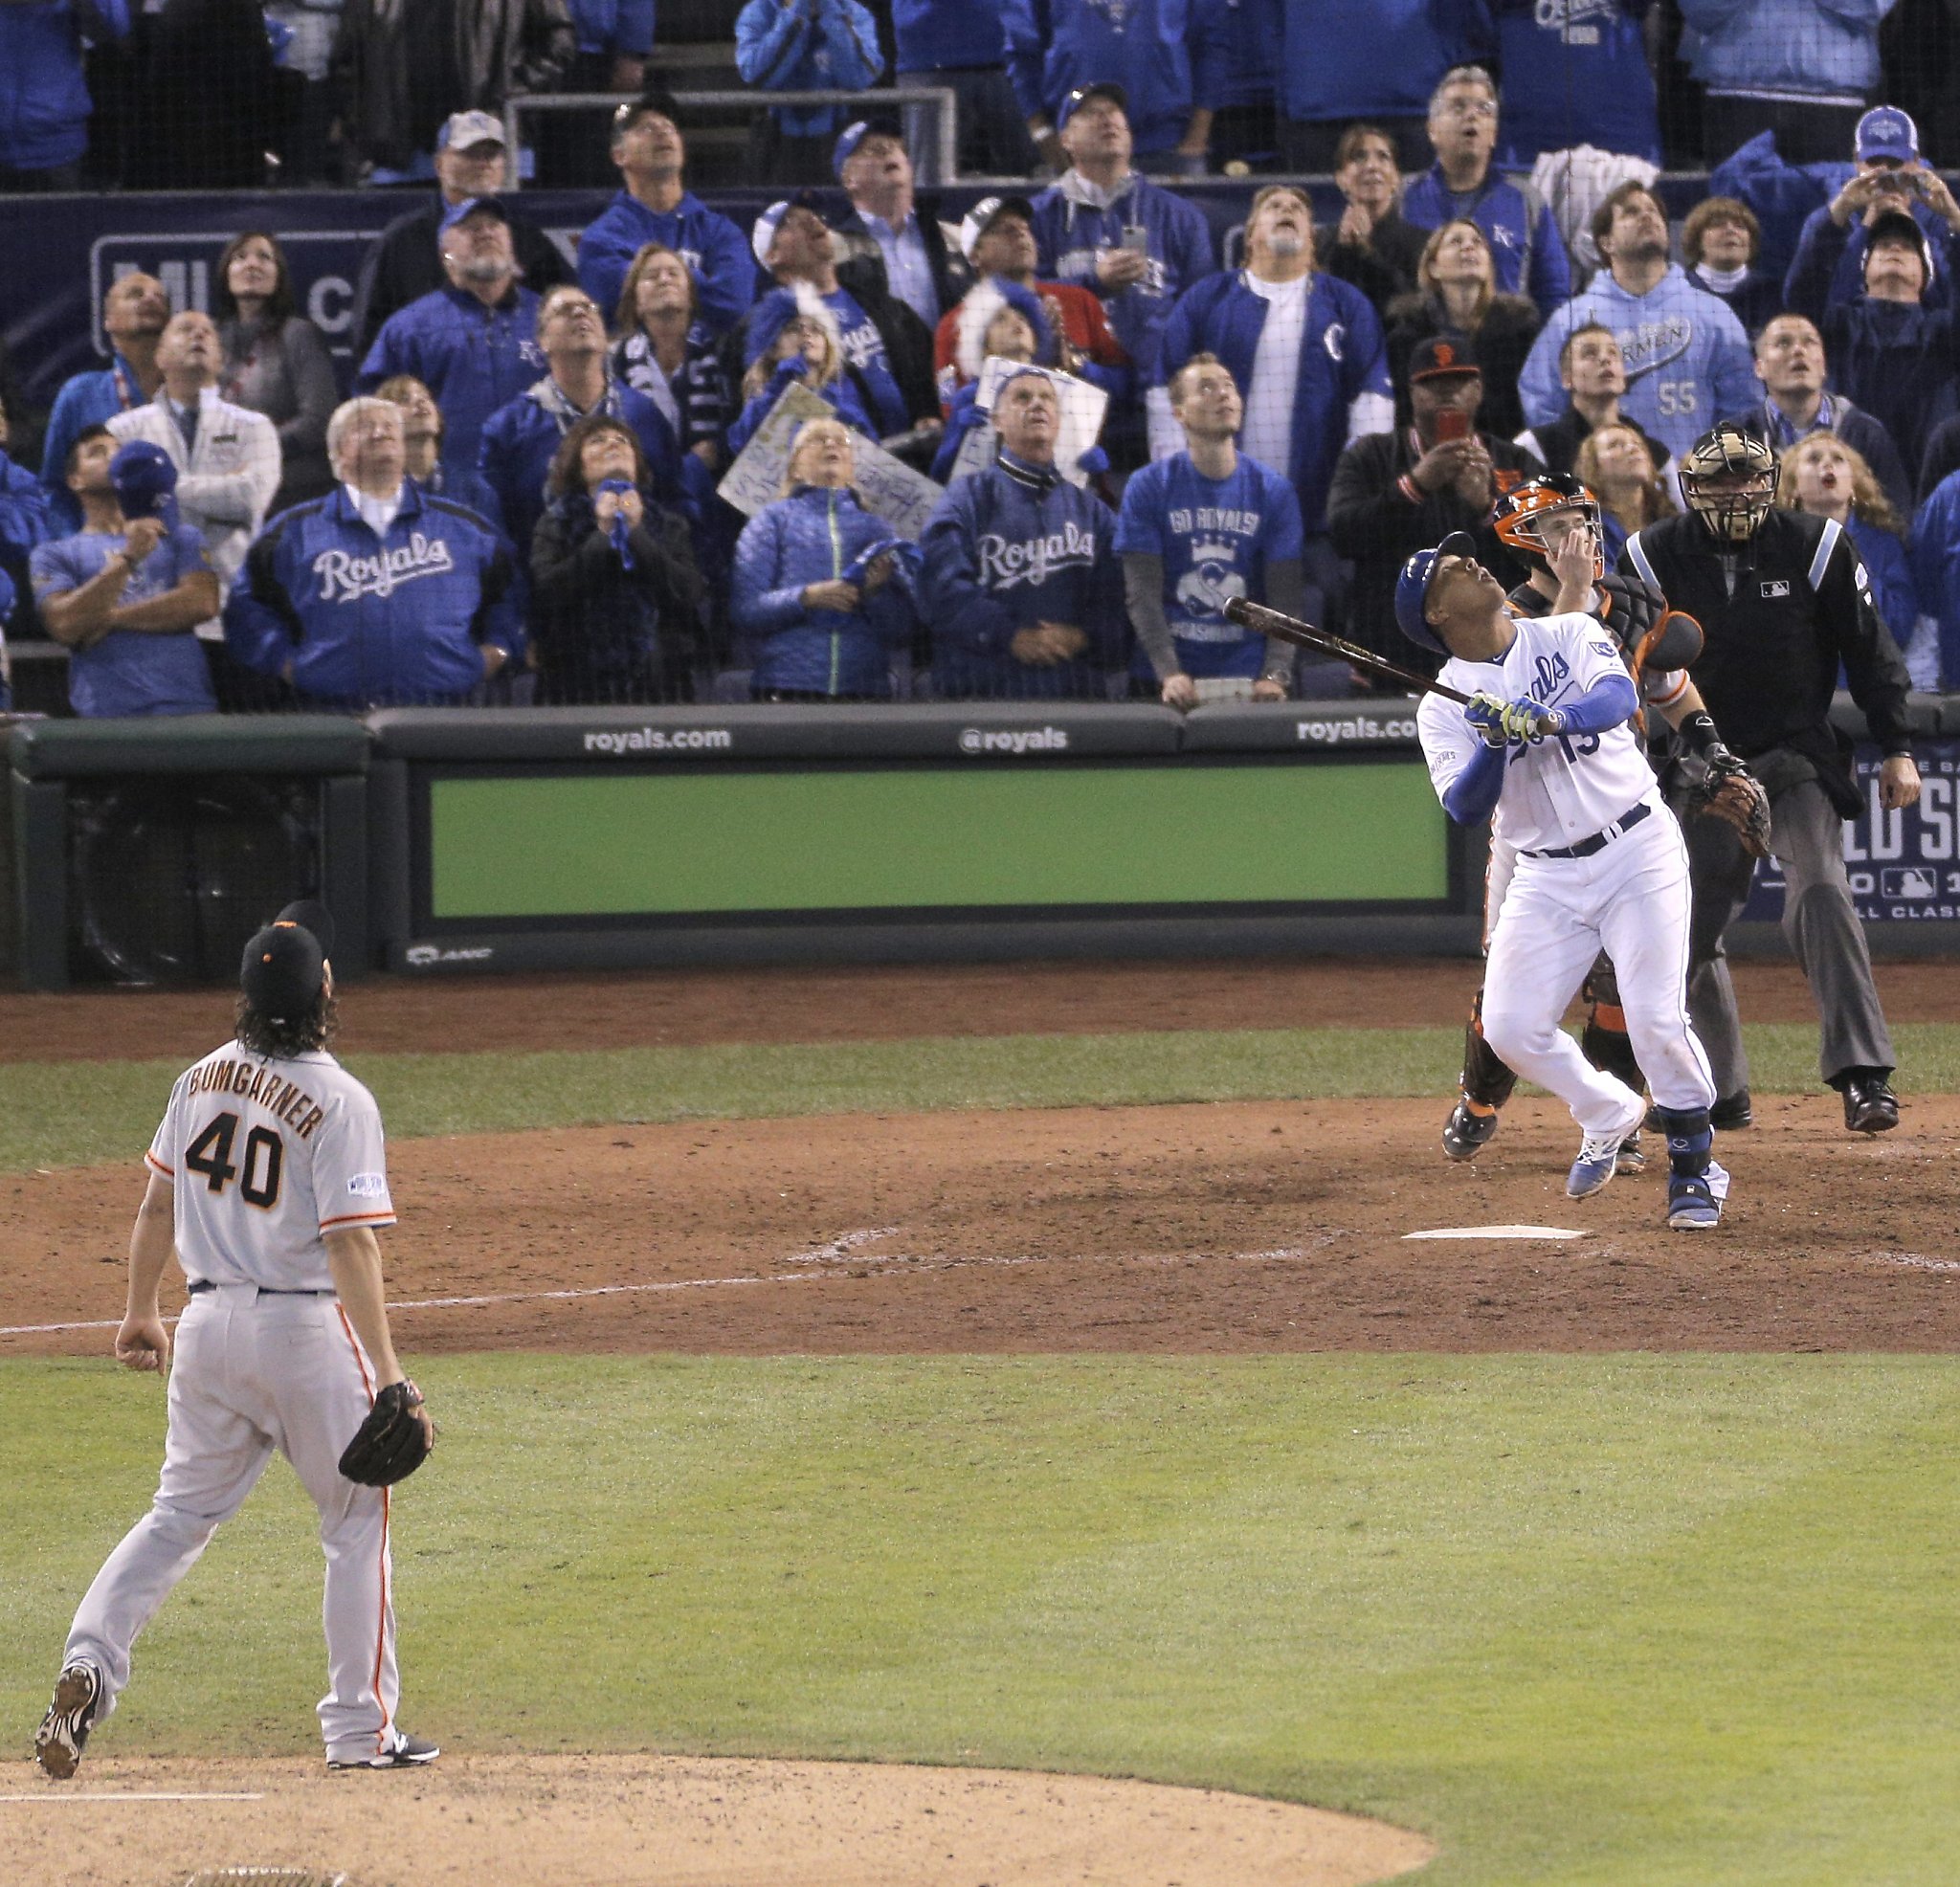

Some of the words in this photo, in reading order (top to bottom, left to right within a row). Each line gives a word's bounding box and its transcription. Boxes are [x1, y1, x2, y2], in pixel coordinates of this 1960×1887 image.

[1659, 382, 1696, 415] 55
[312, 532, 454, 604] Royals
[977, 521, 1094, 589] Royals
[584, 727, 731, 754] royals.com
[959, 726, 1068, 753] @royals
[1297, 717, 1417, 743] royals.co
[189, 1059, 323, 1140] BUMGARNER
[185, 1111, 285, 1210] 40
